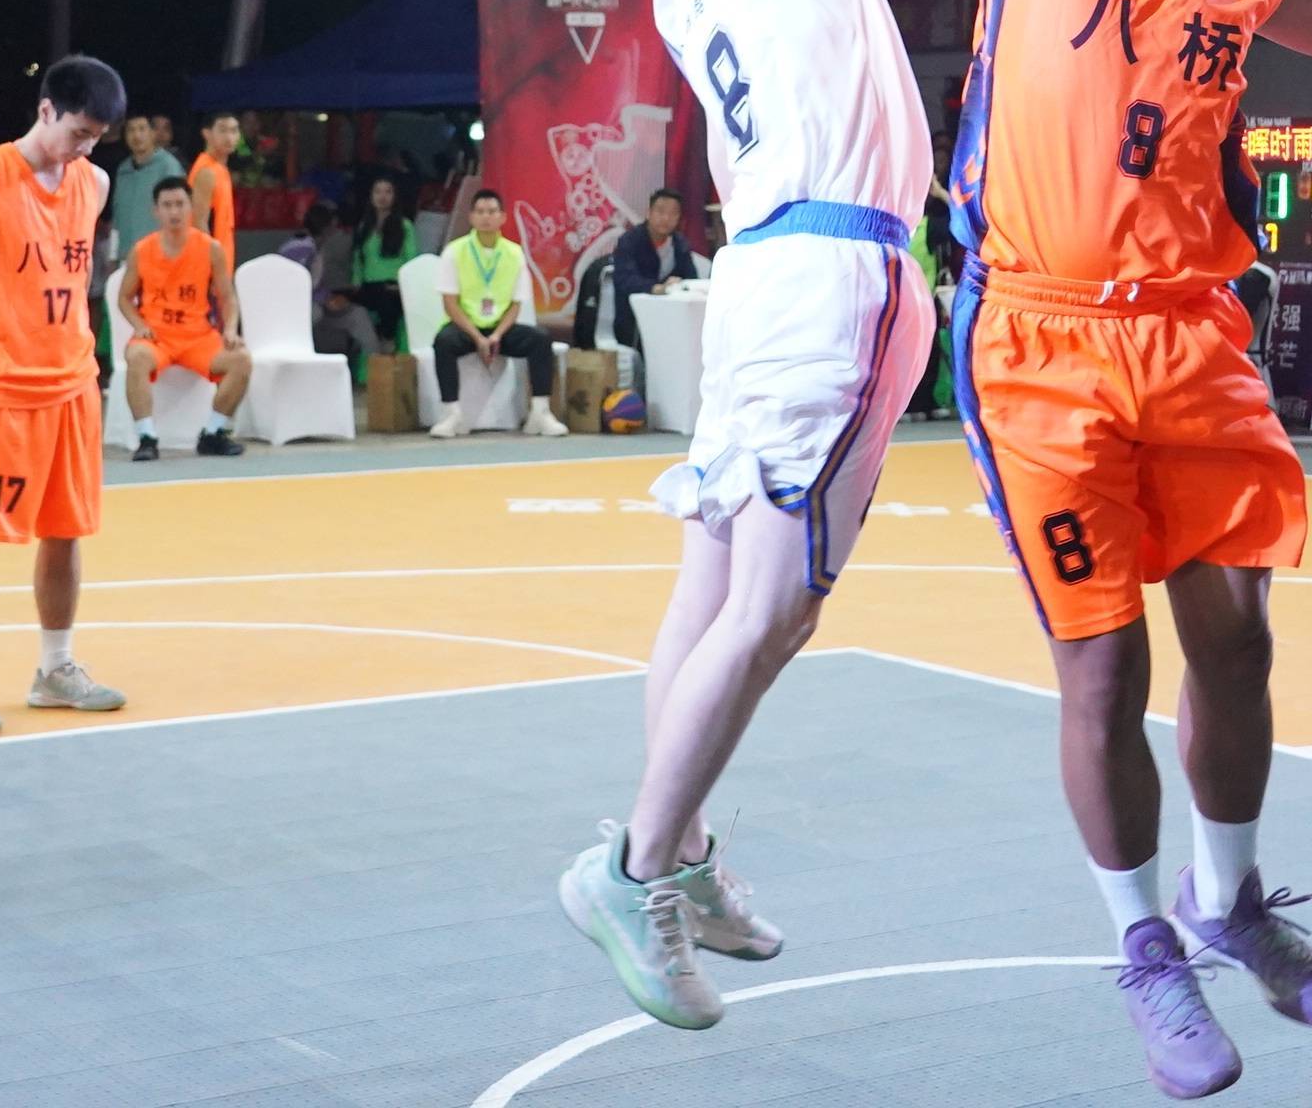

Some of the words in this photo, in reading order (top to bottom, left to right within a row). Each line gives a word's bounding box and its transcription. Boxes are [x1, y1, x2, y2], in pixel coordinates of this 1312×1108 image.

[706, 24, 759, 163] 8
[1117, 99, 1167, 181] 8
[16, 238, 89, 274] 八桥
[1264, 222, 1279, 254] 7
[43, 288, 72, 325] 17
[152, 286, 197, 305] 八桥
[1039, 509, 1097, 586] 8
